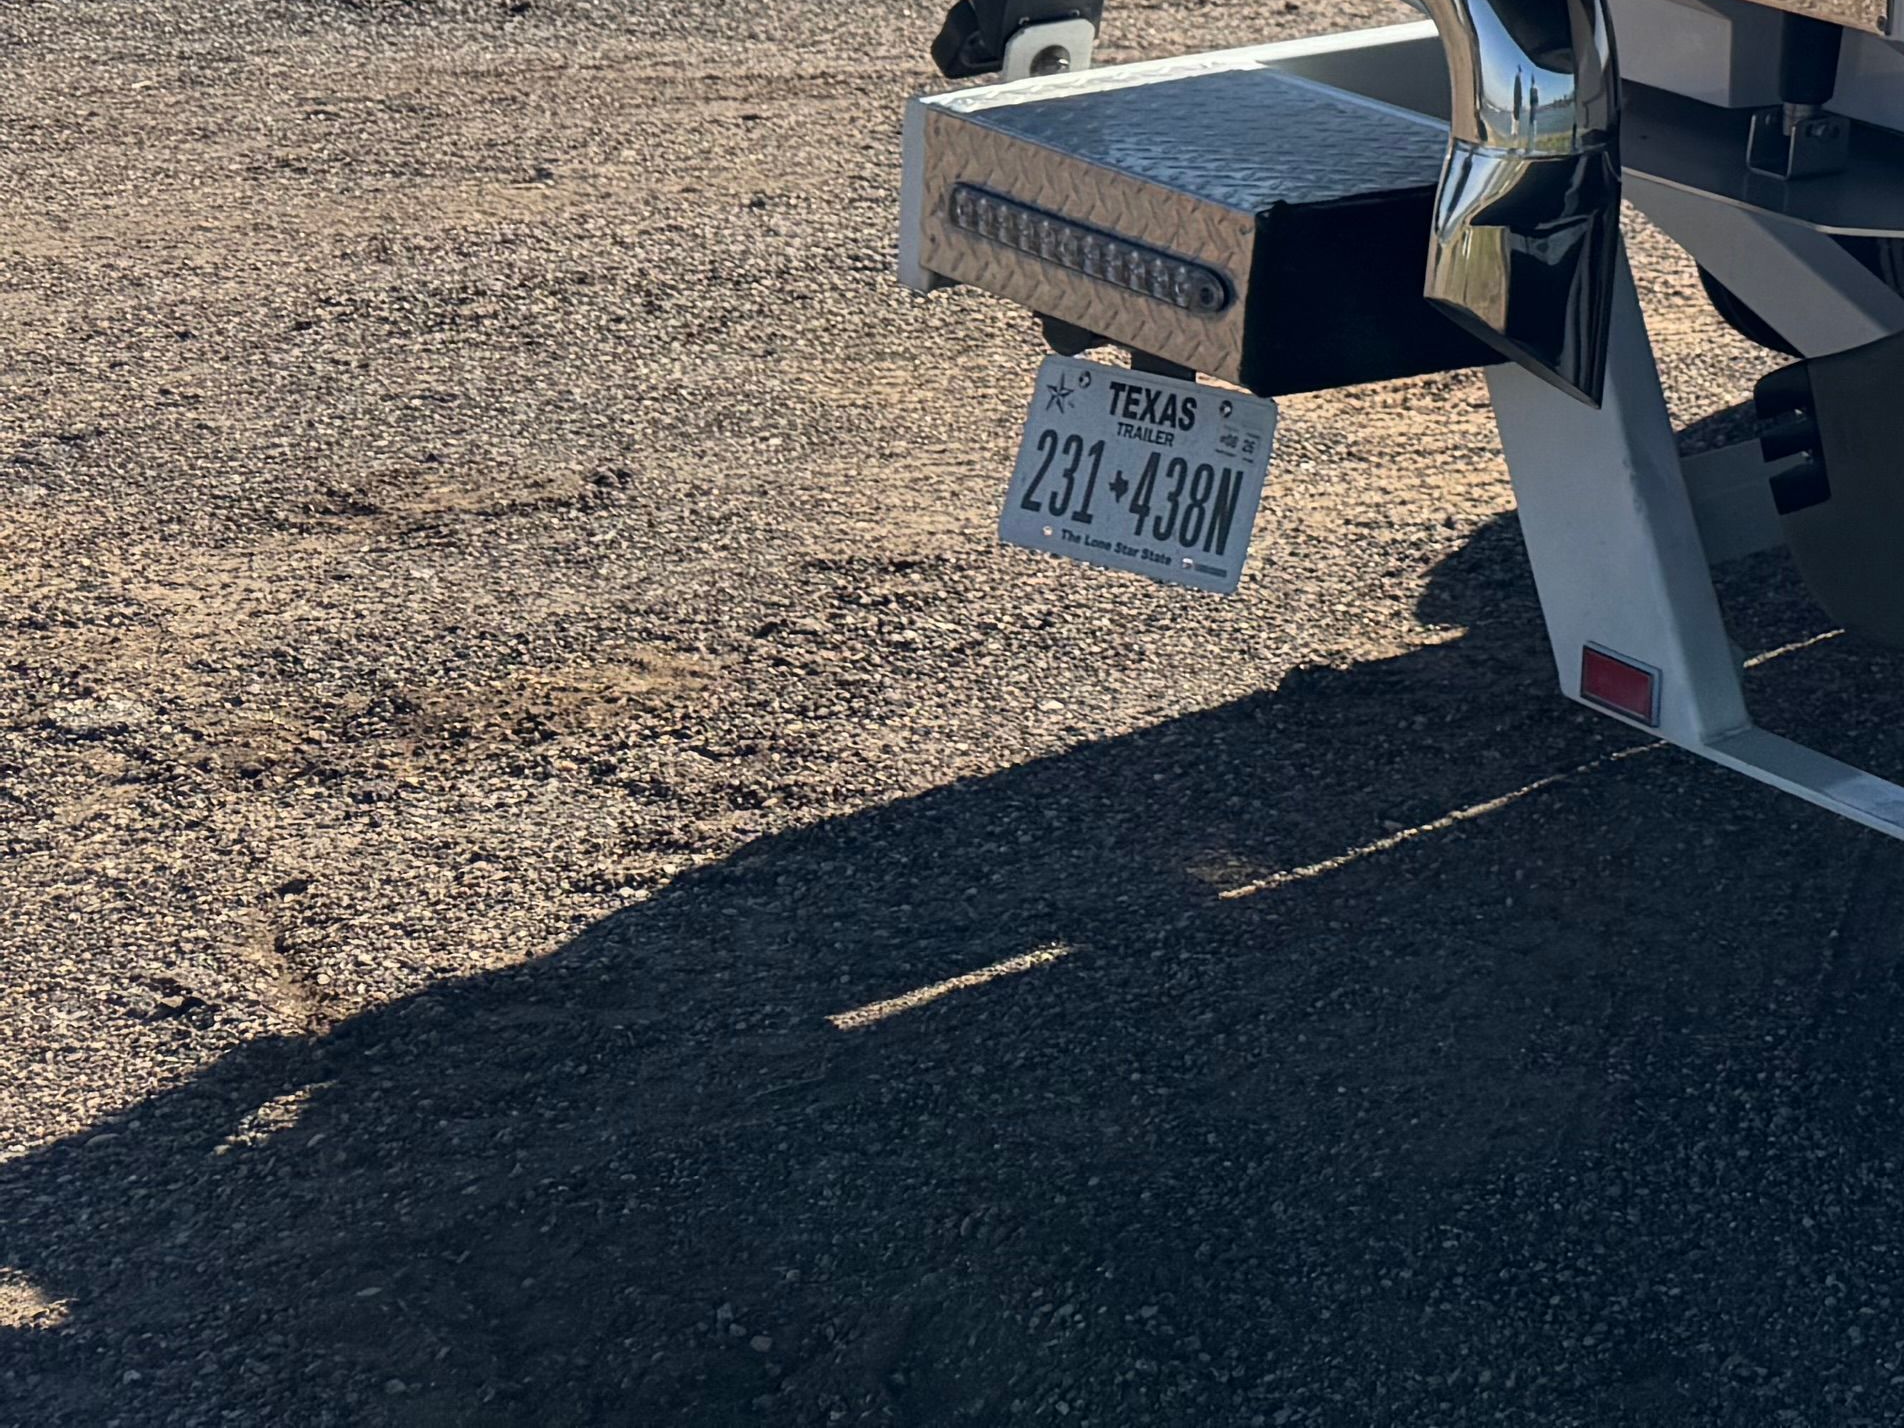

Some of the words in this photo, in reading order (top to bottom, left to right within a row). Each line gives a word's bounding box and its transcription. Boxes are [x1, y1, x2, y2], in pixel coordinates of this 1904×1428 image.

[1108, 380, 1198, 432] TEXAS
[1116, 422, 1176, 448] TRAILER
[1020, 428, 1107, 525] 231
[1128, 451, 1244, 556] 438N
[1061, 528, 1083, 545] The
[1084, 533, 1112, 552] Lone
[1113, 541, 1140, 558] Star
[1141, 547, 1173, 566] State
